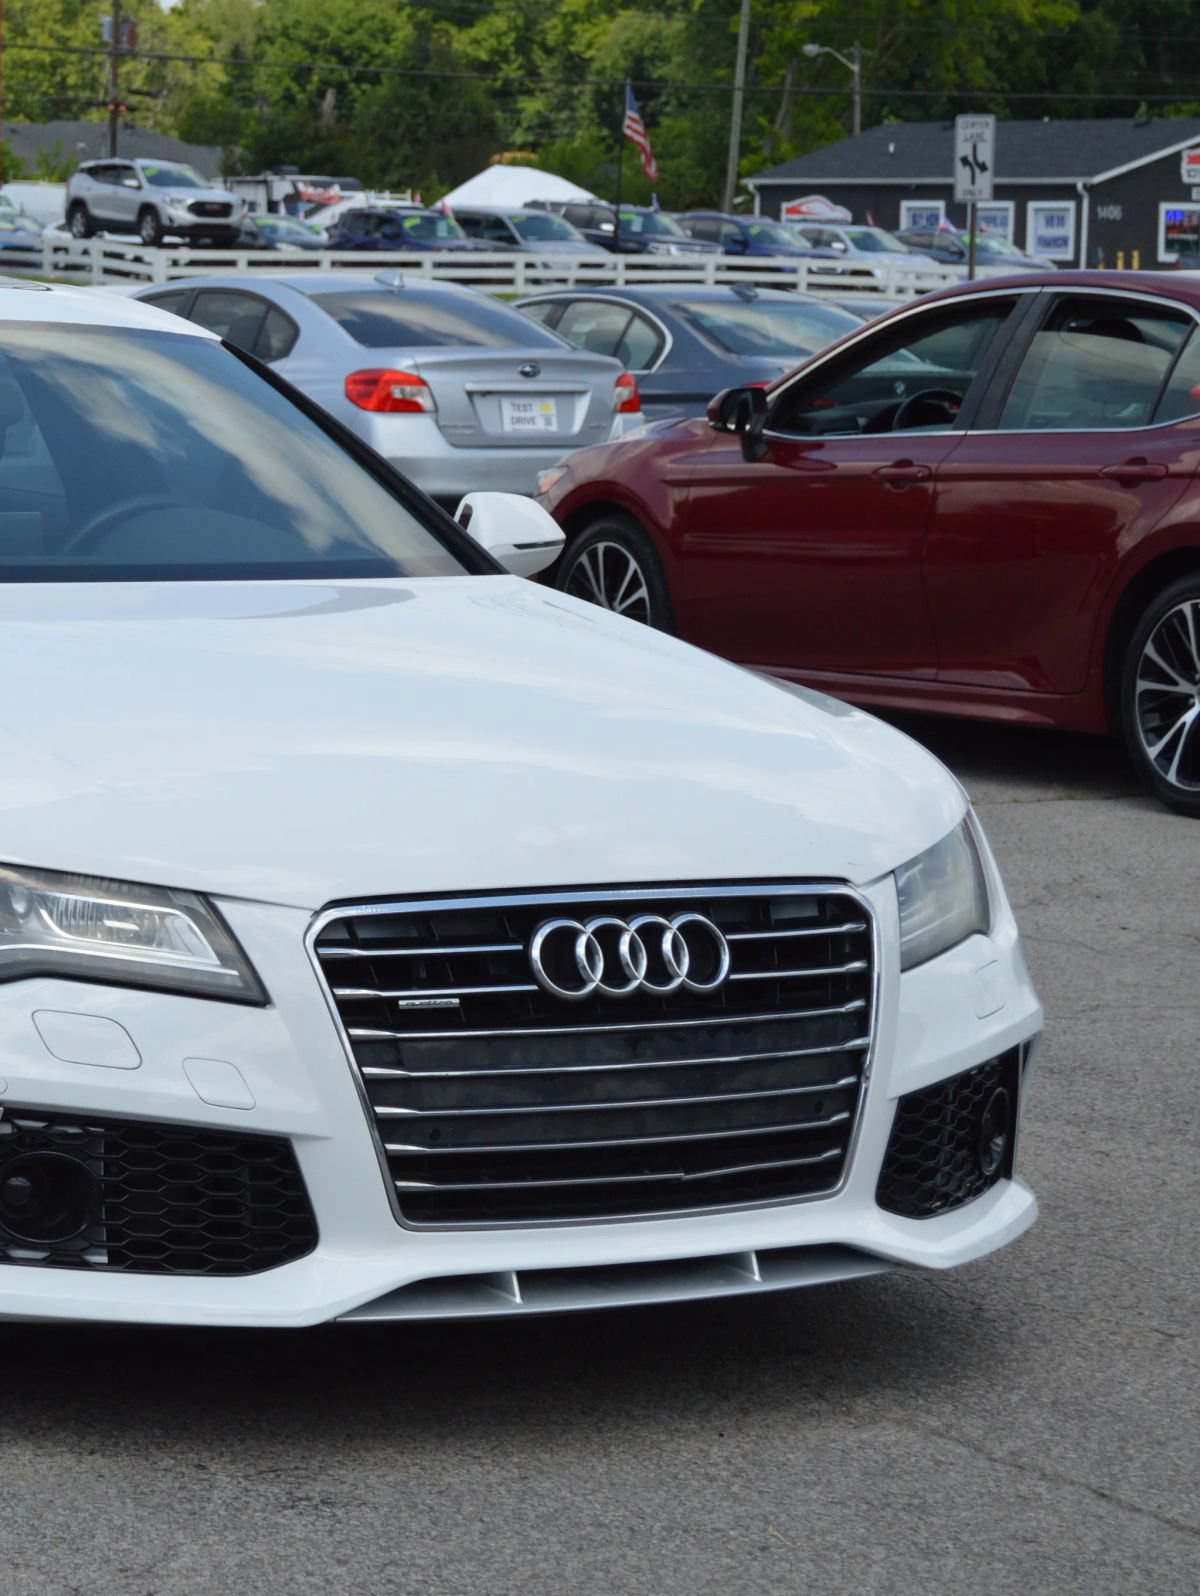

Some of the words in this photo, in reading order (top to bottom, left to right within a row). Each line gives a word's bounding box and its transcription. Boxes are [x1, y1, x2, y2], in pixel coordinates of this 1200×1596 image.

[960, 121, 989, 129] CENTER
[512, 403, 533, 412] TEST
[512, 416, 536, 426] DRIVE
